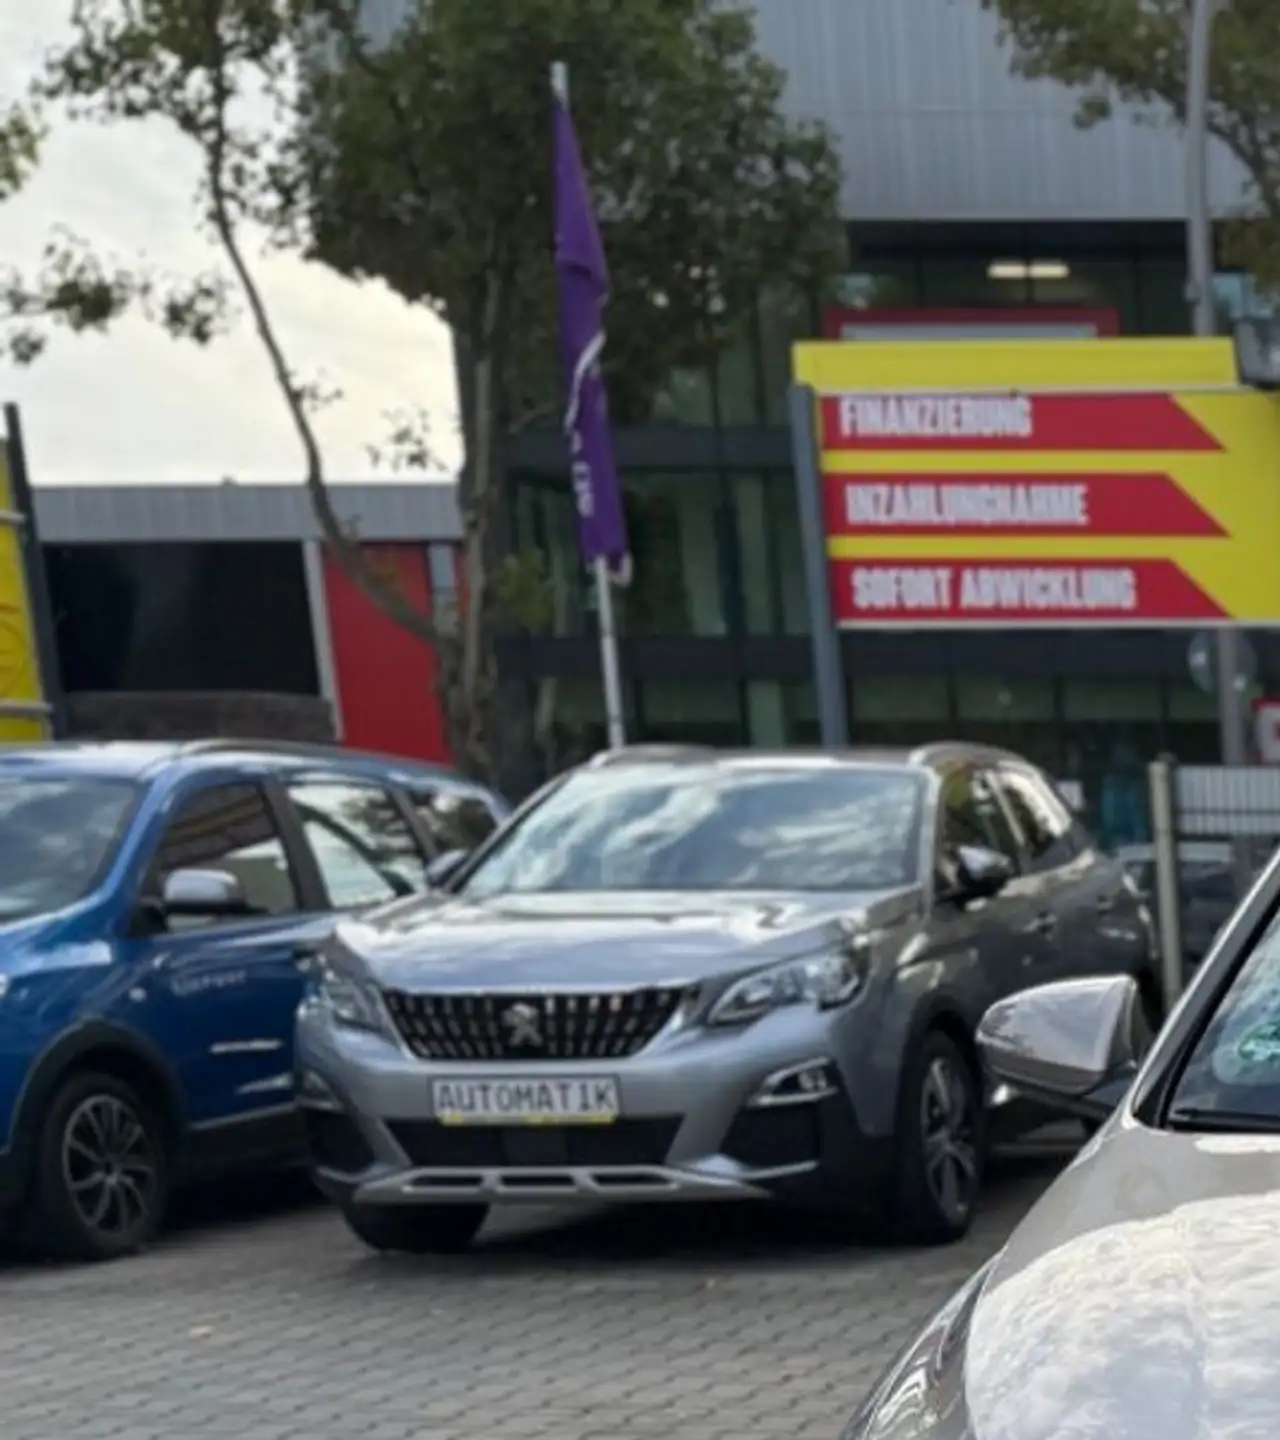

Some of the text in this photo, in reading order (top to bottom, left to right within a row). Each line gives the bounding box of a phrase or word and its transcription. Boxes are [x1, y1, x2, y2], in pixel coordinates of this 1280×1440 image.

[851, 567, 1138, 610] SOFORT ABWICKLUNG
[438, 1083, 615, 1112] AUTOMATIK
